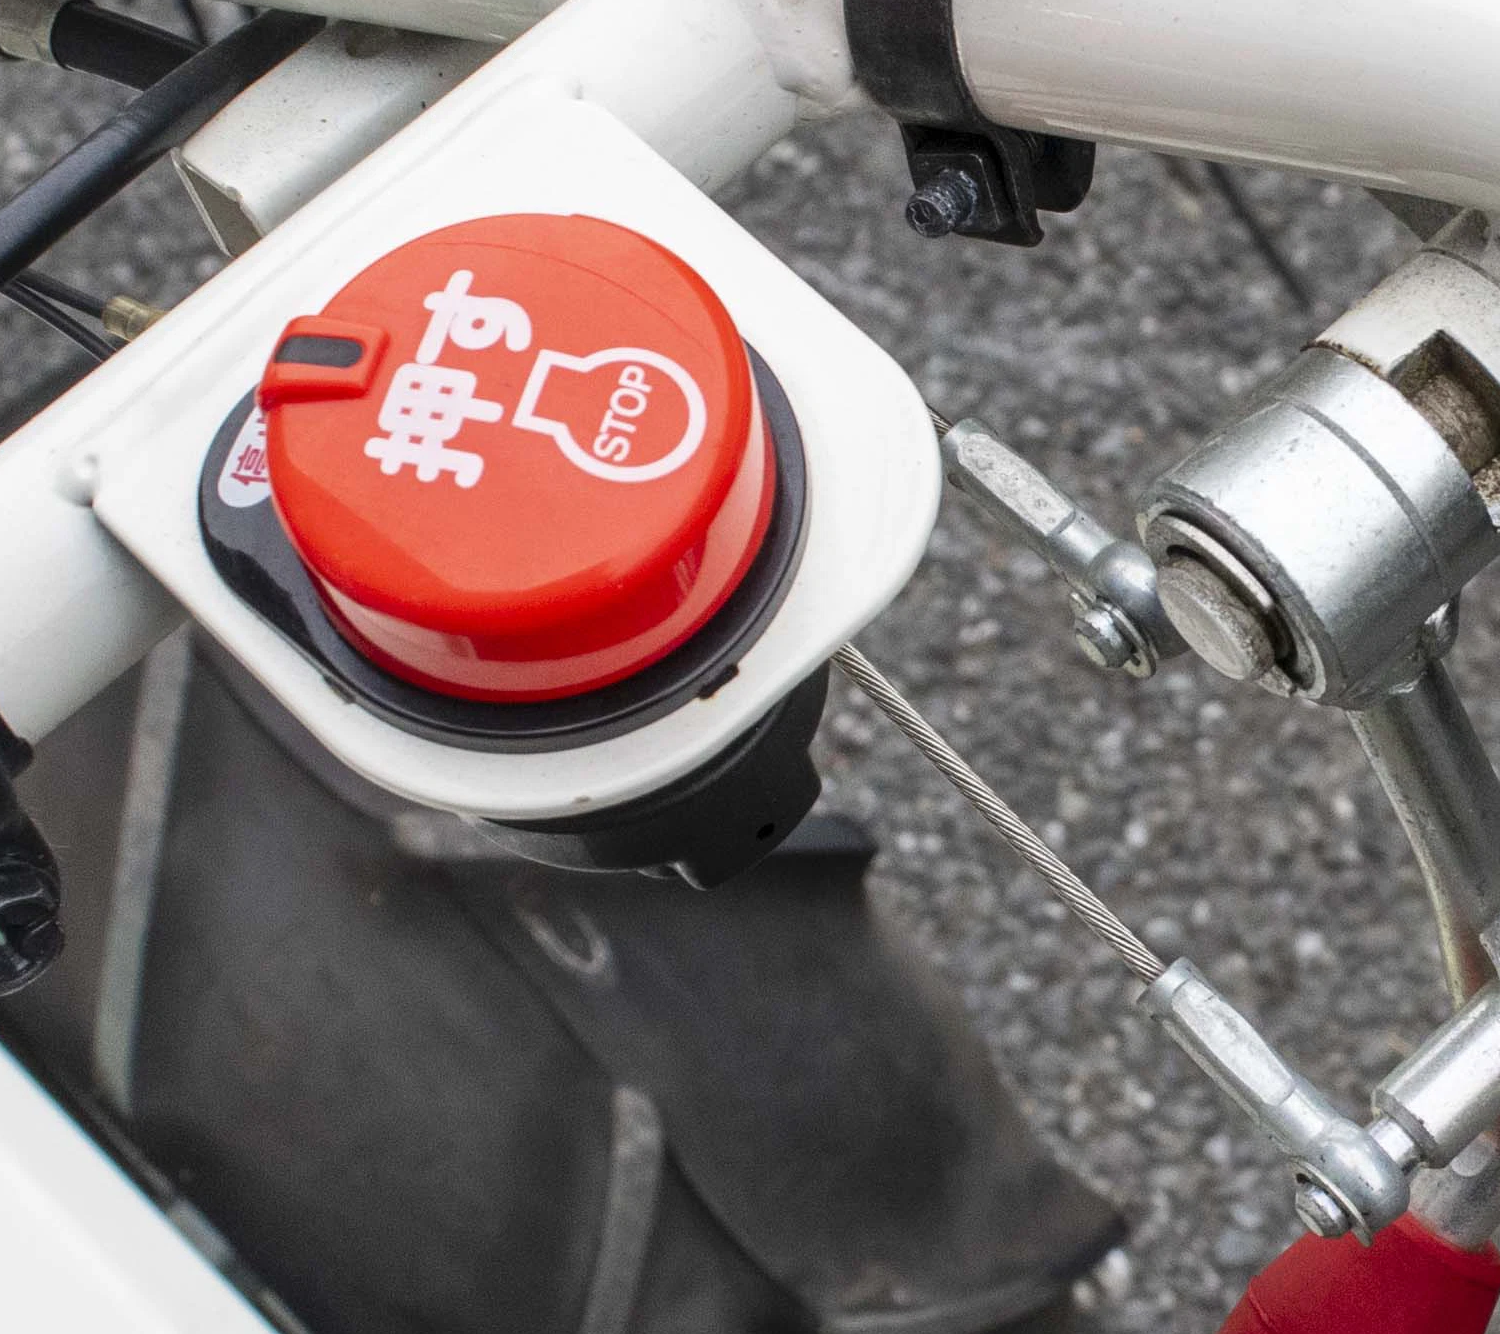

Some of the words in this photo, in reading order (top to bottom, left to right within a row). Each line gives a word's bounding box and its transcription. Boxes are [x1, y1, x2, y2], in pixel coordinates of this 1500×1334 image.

[363, 269, 533, 489] 押す
[593, 364, 653, 463] STOP
[231, 418, 268, 485] 停
